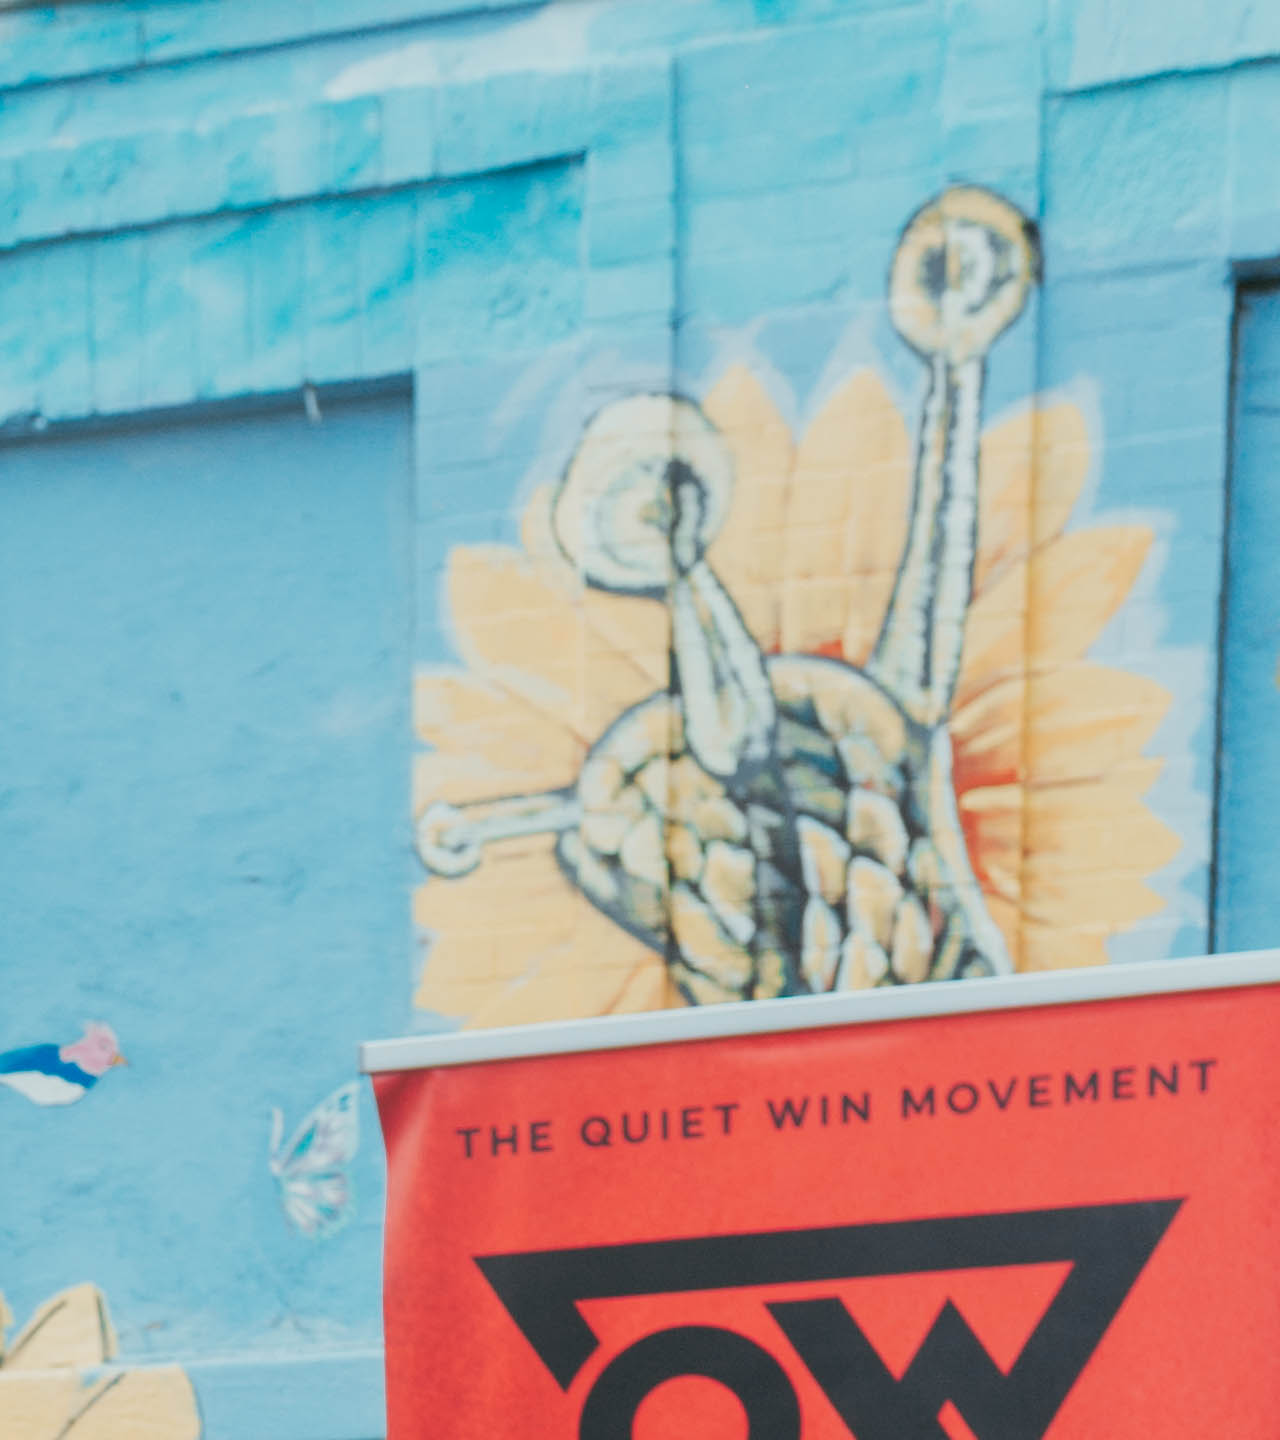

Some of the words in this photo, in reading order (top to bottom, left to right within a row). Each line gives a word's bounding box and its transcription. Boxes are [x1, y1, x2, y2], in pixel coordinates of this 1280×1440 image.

[456, 1120, 556, 1160] THE
[580, 1103, 741, 1150] QUIET
[766, 1090, 871, 1132] WIN
[900, 1058, 1219, 1121] MOVEMENT
